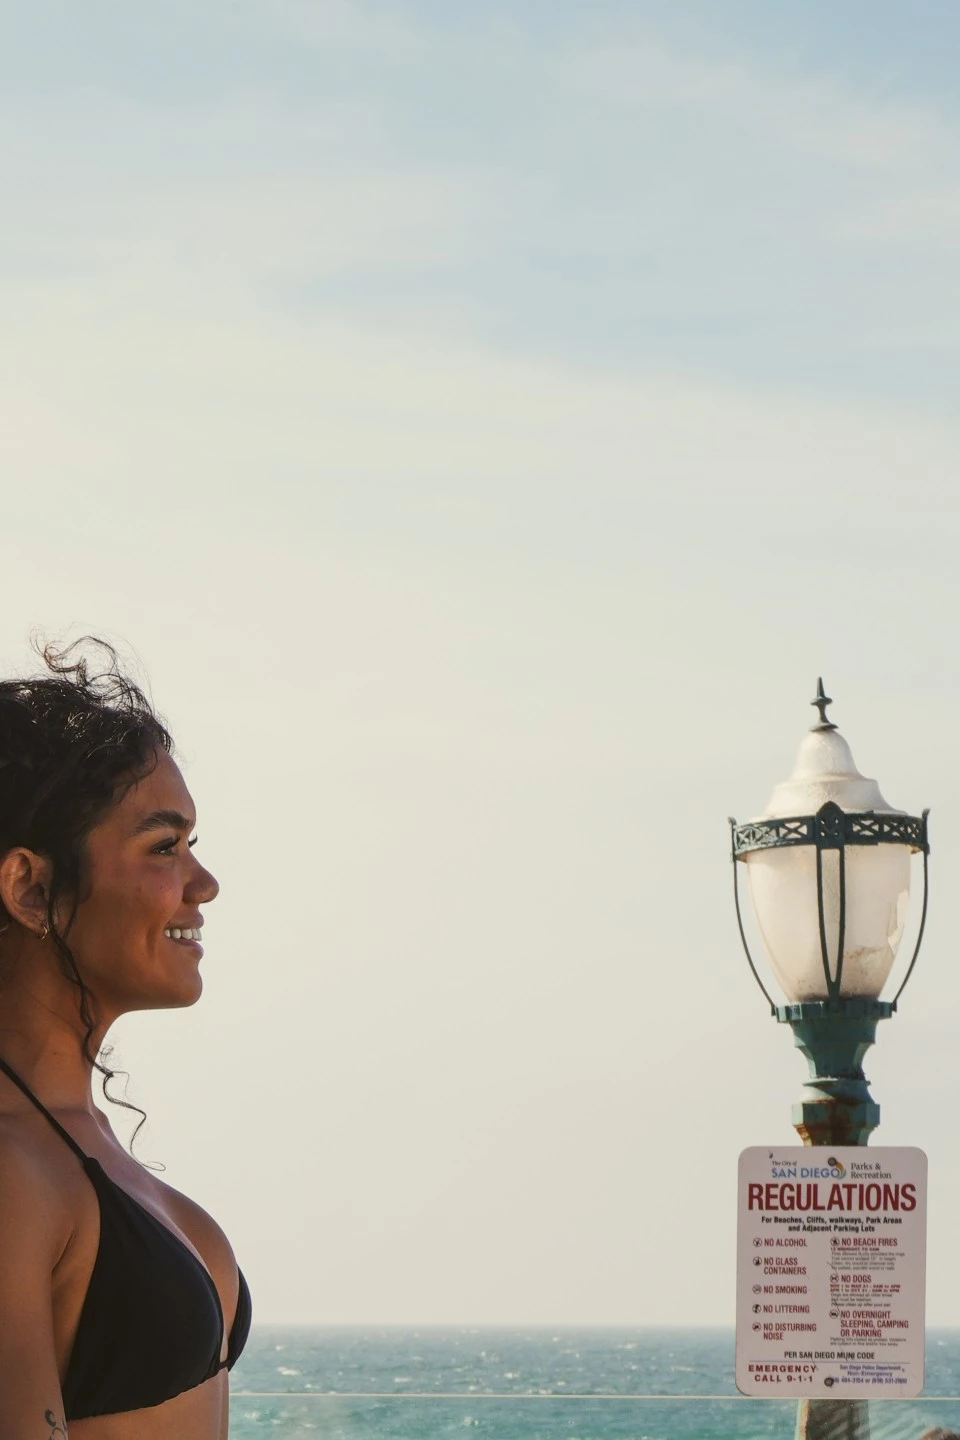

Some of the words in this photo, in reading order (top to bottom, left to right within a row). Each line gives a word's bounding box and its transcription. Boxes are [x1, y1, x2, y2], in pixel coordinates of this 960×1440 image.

[851, 1162, 873, 1170] Parks
[874, 1162, 881, 1170] &
[772, 1168, 797, 1178] SAN
[801, 1168, 840, 1178] DIEGO
[851, 1171, 892, 1179] Recreation
[748, 1183, 917, 1212] REGULATIONS
[761, 1216, 773, 1224] For
[774, 1216, 804, 1225] Beaches,
[806, 1216, 827, 1225] Cliffs,
[829, 1216, 864, 1225] walkways,
[866, 1217, 881, 1225] Park
[883, 1217, 902, 1225] Areas
[802, 1225, 832, 1233] Adjacent
[833, 1225, 859, 1233] Parking
[764, 1238, 774, 1247] NO
[776, 1238, 808, 1247] ALCOHOL
[841, 1237, 852, 1247] NO
[853, 1237, 877, 1247] BEACH
[878, 1237, 898, 1247] FIRES
[764, 1257, 774, 1266] NO
[775, 1257, 798, 1266] GLASS
[763, 1266, 807, 1275] CONTAINERS
[841, 1274, 851, 1283] NO
[853, 1274, 872, 1283] DOGS
[763, 1285, 774, 1294] NO
[775, 1285, 808, 1294] SMOKING
[763, 1305, 773, 1313] NO
[775, 1305, 810, 1314] LITTERING
[840, 1310, 851, 1319] NO
[852, 1310, 891, 1319] OVERNIGHT
[763, 1323, 773, 1331] NO
[775, 1323, 817, 1332] DISTURBING
[840, 1320, 876, 1329] SLEEPING,
[877, 1320, 909, 1328] CAMPING
[763, 1332, 783, 1341] NOISE
[840, 1329, 850, 1337] OR
[852, 1329, 882, 1337] PARKING
[837, 1352, 855, 1360] MUNI
[857, 1352, 875, 1360] CODE
[748, 1365, 817, 1373] EMERGENCY
[754, 1375, 782, 1383] CALL
